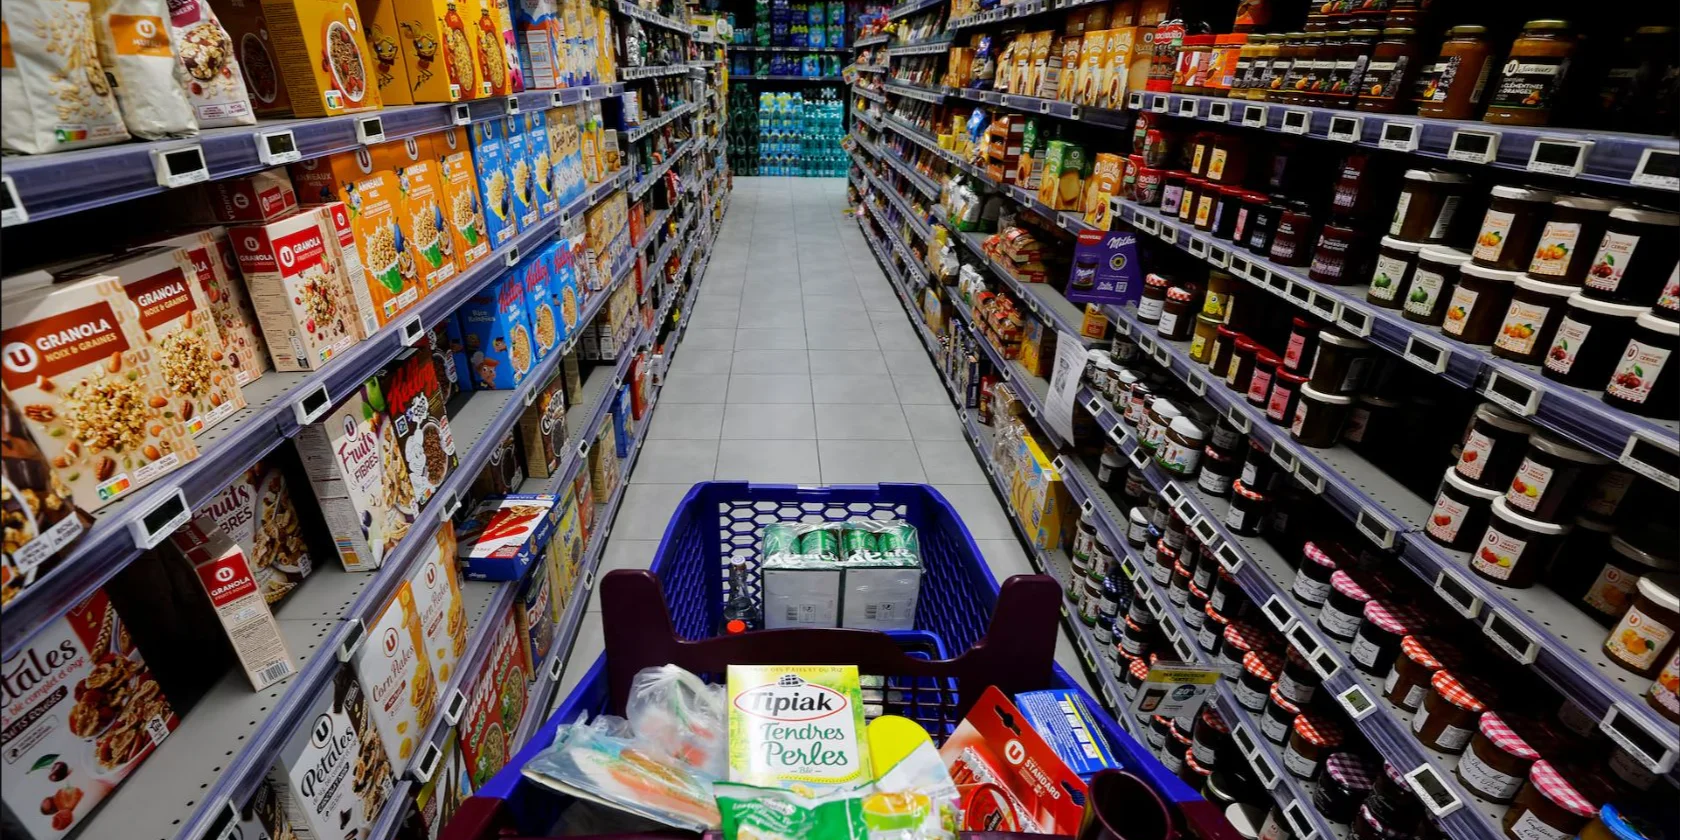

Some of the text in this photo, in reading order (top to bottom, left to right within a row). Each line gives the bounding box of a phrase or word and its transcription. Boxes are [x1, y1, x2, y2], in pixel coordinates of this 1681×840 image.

[293, 237, 321, 254] GRANOLA
[1106, 236, 1136, 249] Milka
[240, 254, 274, 262] GRANOLA
[137, 281, 185, 308] GRANOLA
[144, 303, 160, 318] NOIX
[164, 293, 189, 308] GRAINES
[35, 317, 112, 351] GRANOLA
[44, 346, 71, 363] NOIX
[78, 331, 118, 351] GRAINES
[8, 348, 32, 367] U
[338, 431, 376, 475] Fruits
[354, 452, 379, 483] FIBRES
[211, 577, 252, 596] GRANOLA
[372, 675, 393, 703] Corn
[391, 645, 414, 678] Flakes
[750, 692, 832, 716] Tipiak
[760, 722, 845, 741] Tendres
[301, 726, 354, 798] Pétales
[761, 741, 848, 767] Perles
[1024, 759, 1061, 800] STANDARD
